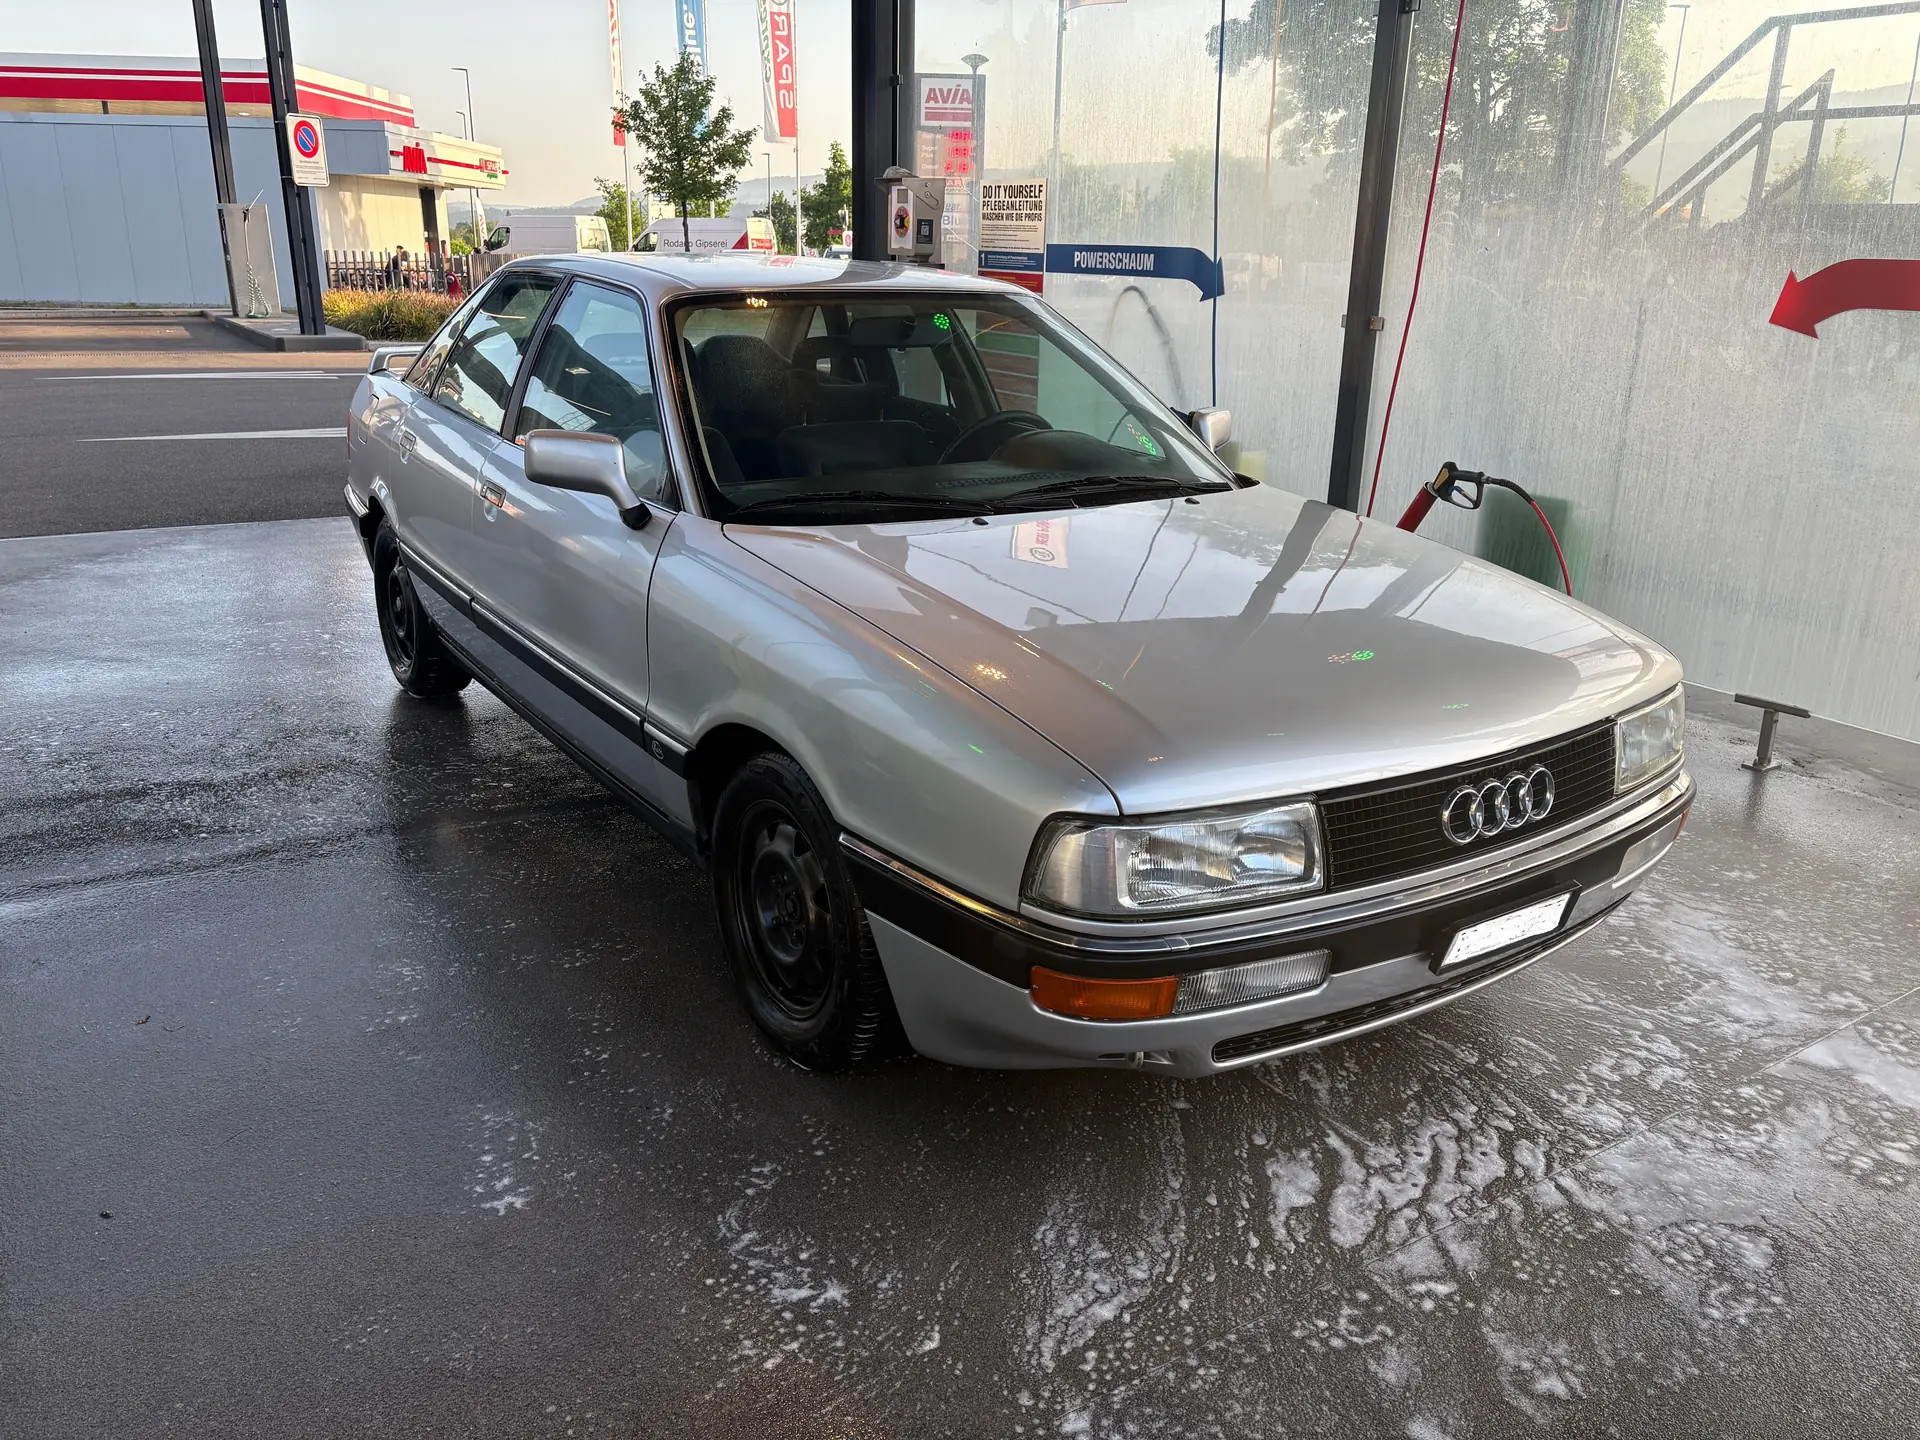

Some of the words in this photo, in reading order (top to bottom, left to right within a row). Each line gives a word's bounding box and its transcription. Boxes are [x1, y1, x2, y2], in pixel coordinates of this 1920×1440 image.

[983, 185, 993, 199] DO
[994, 185, 1002, 199] IT
[1003, 184, 1043, 199] YOURSELF
[982, 200, 1043, 212] PFLEGEANLEITUNG
[982, 211, 1004, 221] WASCHEN
[1005, 212, 1014, 221] WIE
[1015, 212, 1023, 221] DIE
[1024, 212, 1042, 222] PROFIS
[663, 239, 693, 248] Rodao
[695, 239, 728, 249] Gipserei
[980, 252, 985, 267] 1
[1074, 251, 1155, 271] POWERSCHAUM
